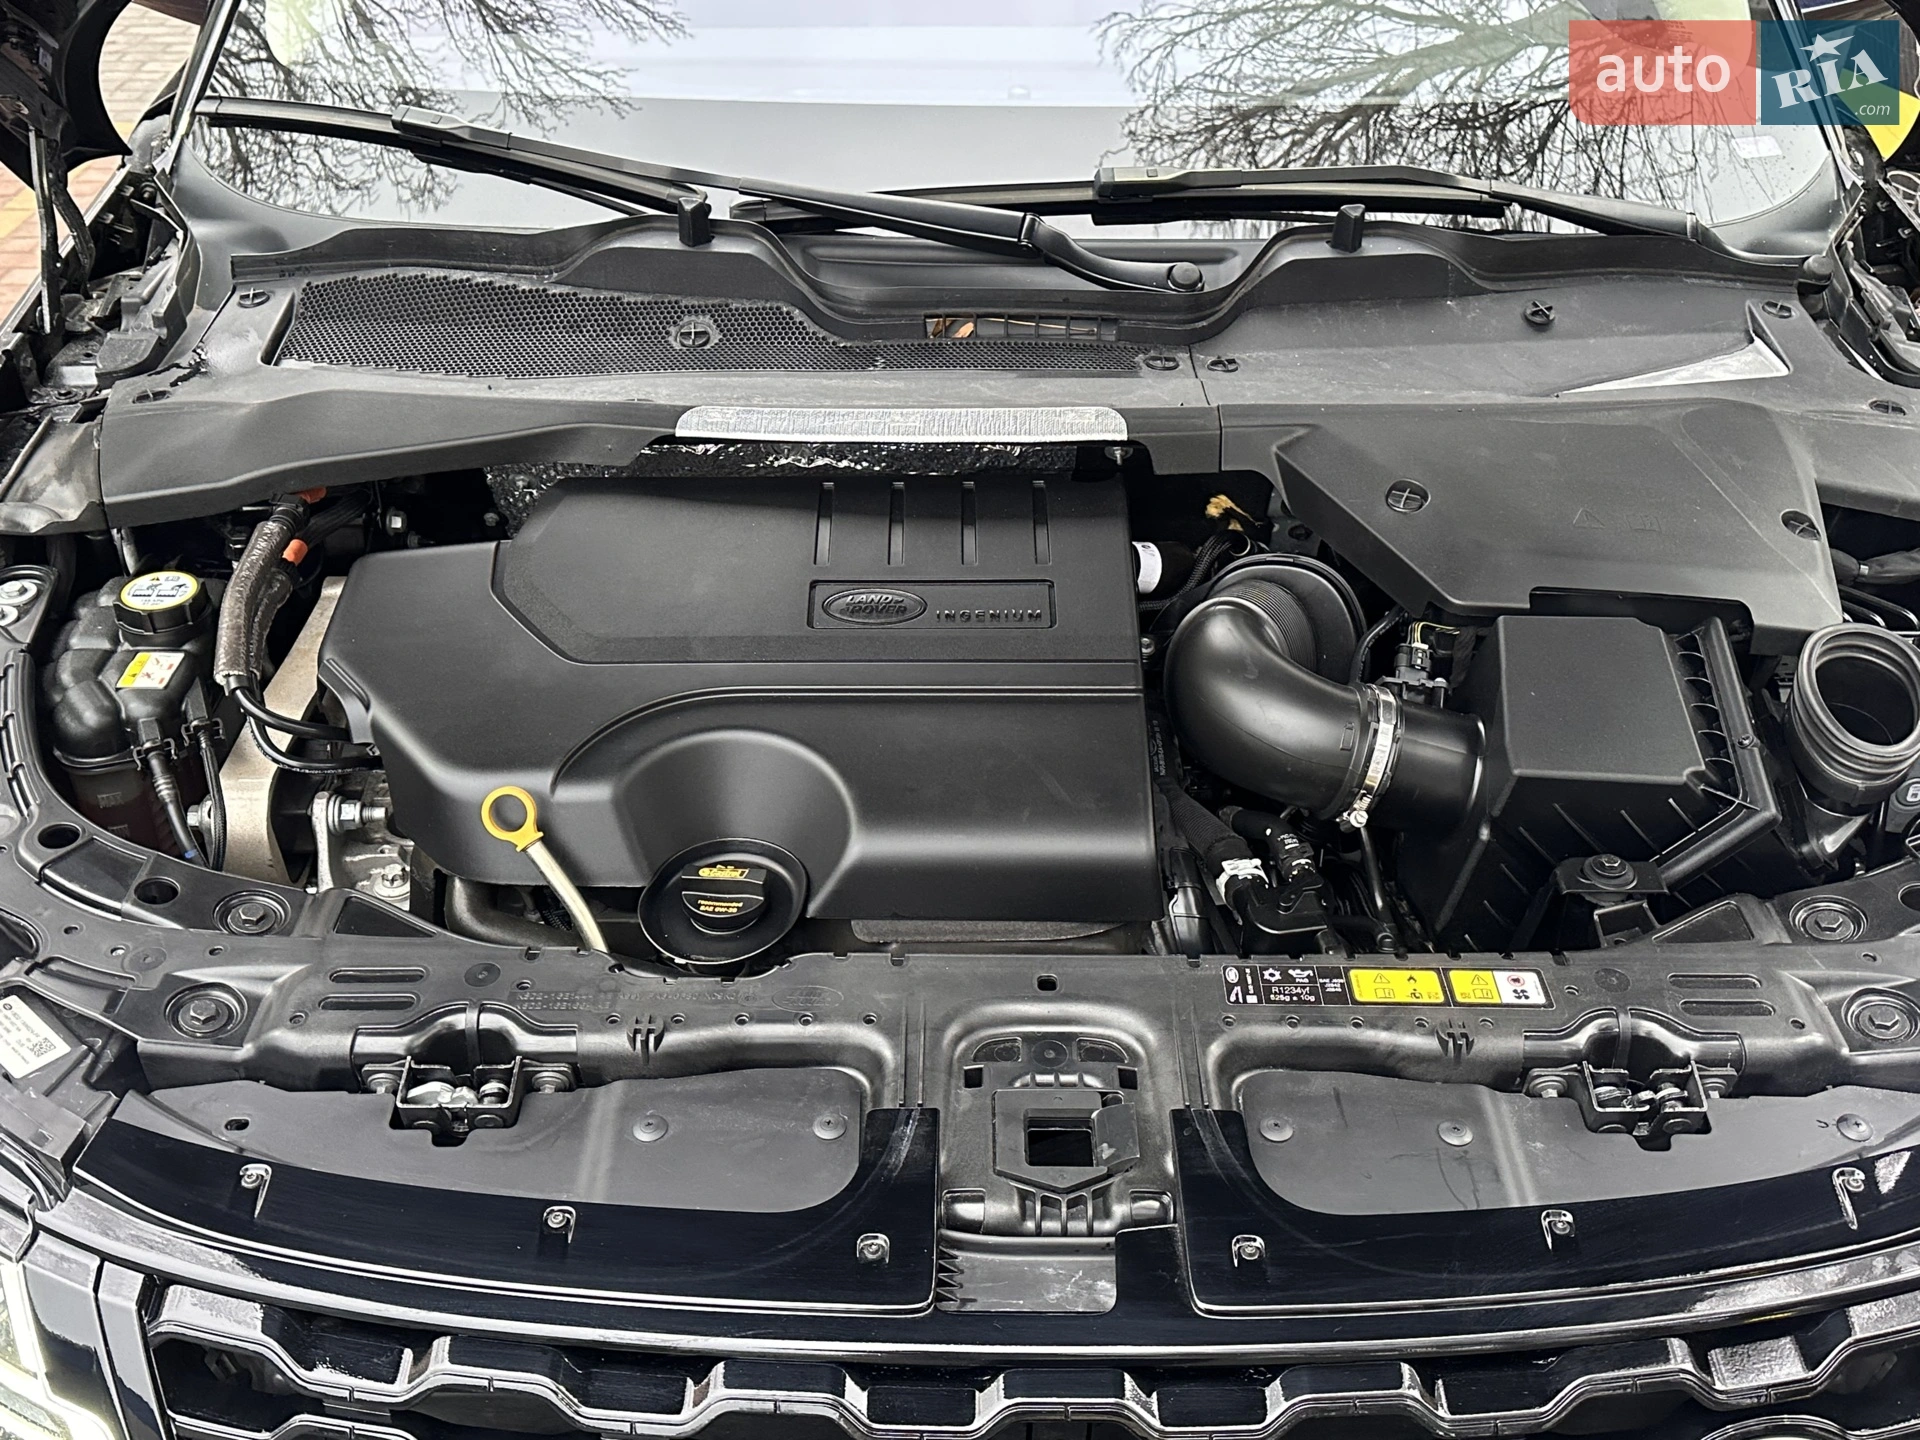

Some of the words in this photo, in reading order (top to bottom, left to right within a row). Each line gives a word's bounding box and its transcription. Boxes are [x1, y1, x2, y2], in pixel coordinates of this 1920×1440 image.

[845, 594, 895, 605] LAND
[854, 604, 908, 616] ROVER
[935, 609, 1042, 623] INGENIUM
[1272, 987, 1310, 995] R1234yf
[1300, 994, 1316, 1002] 10g
